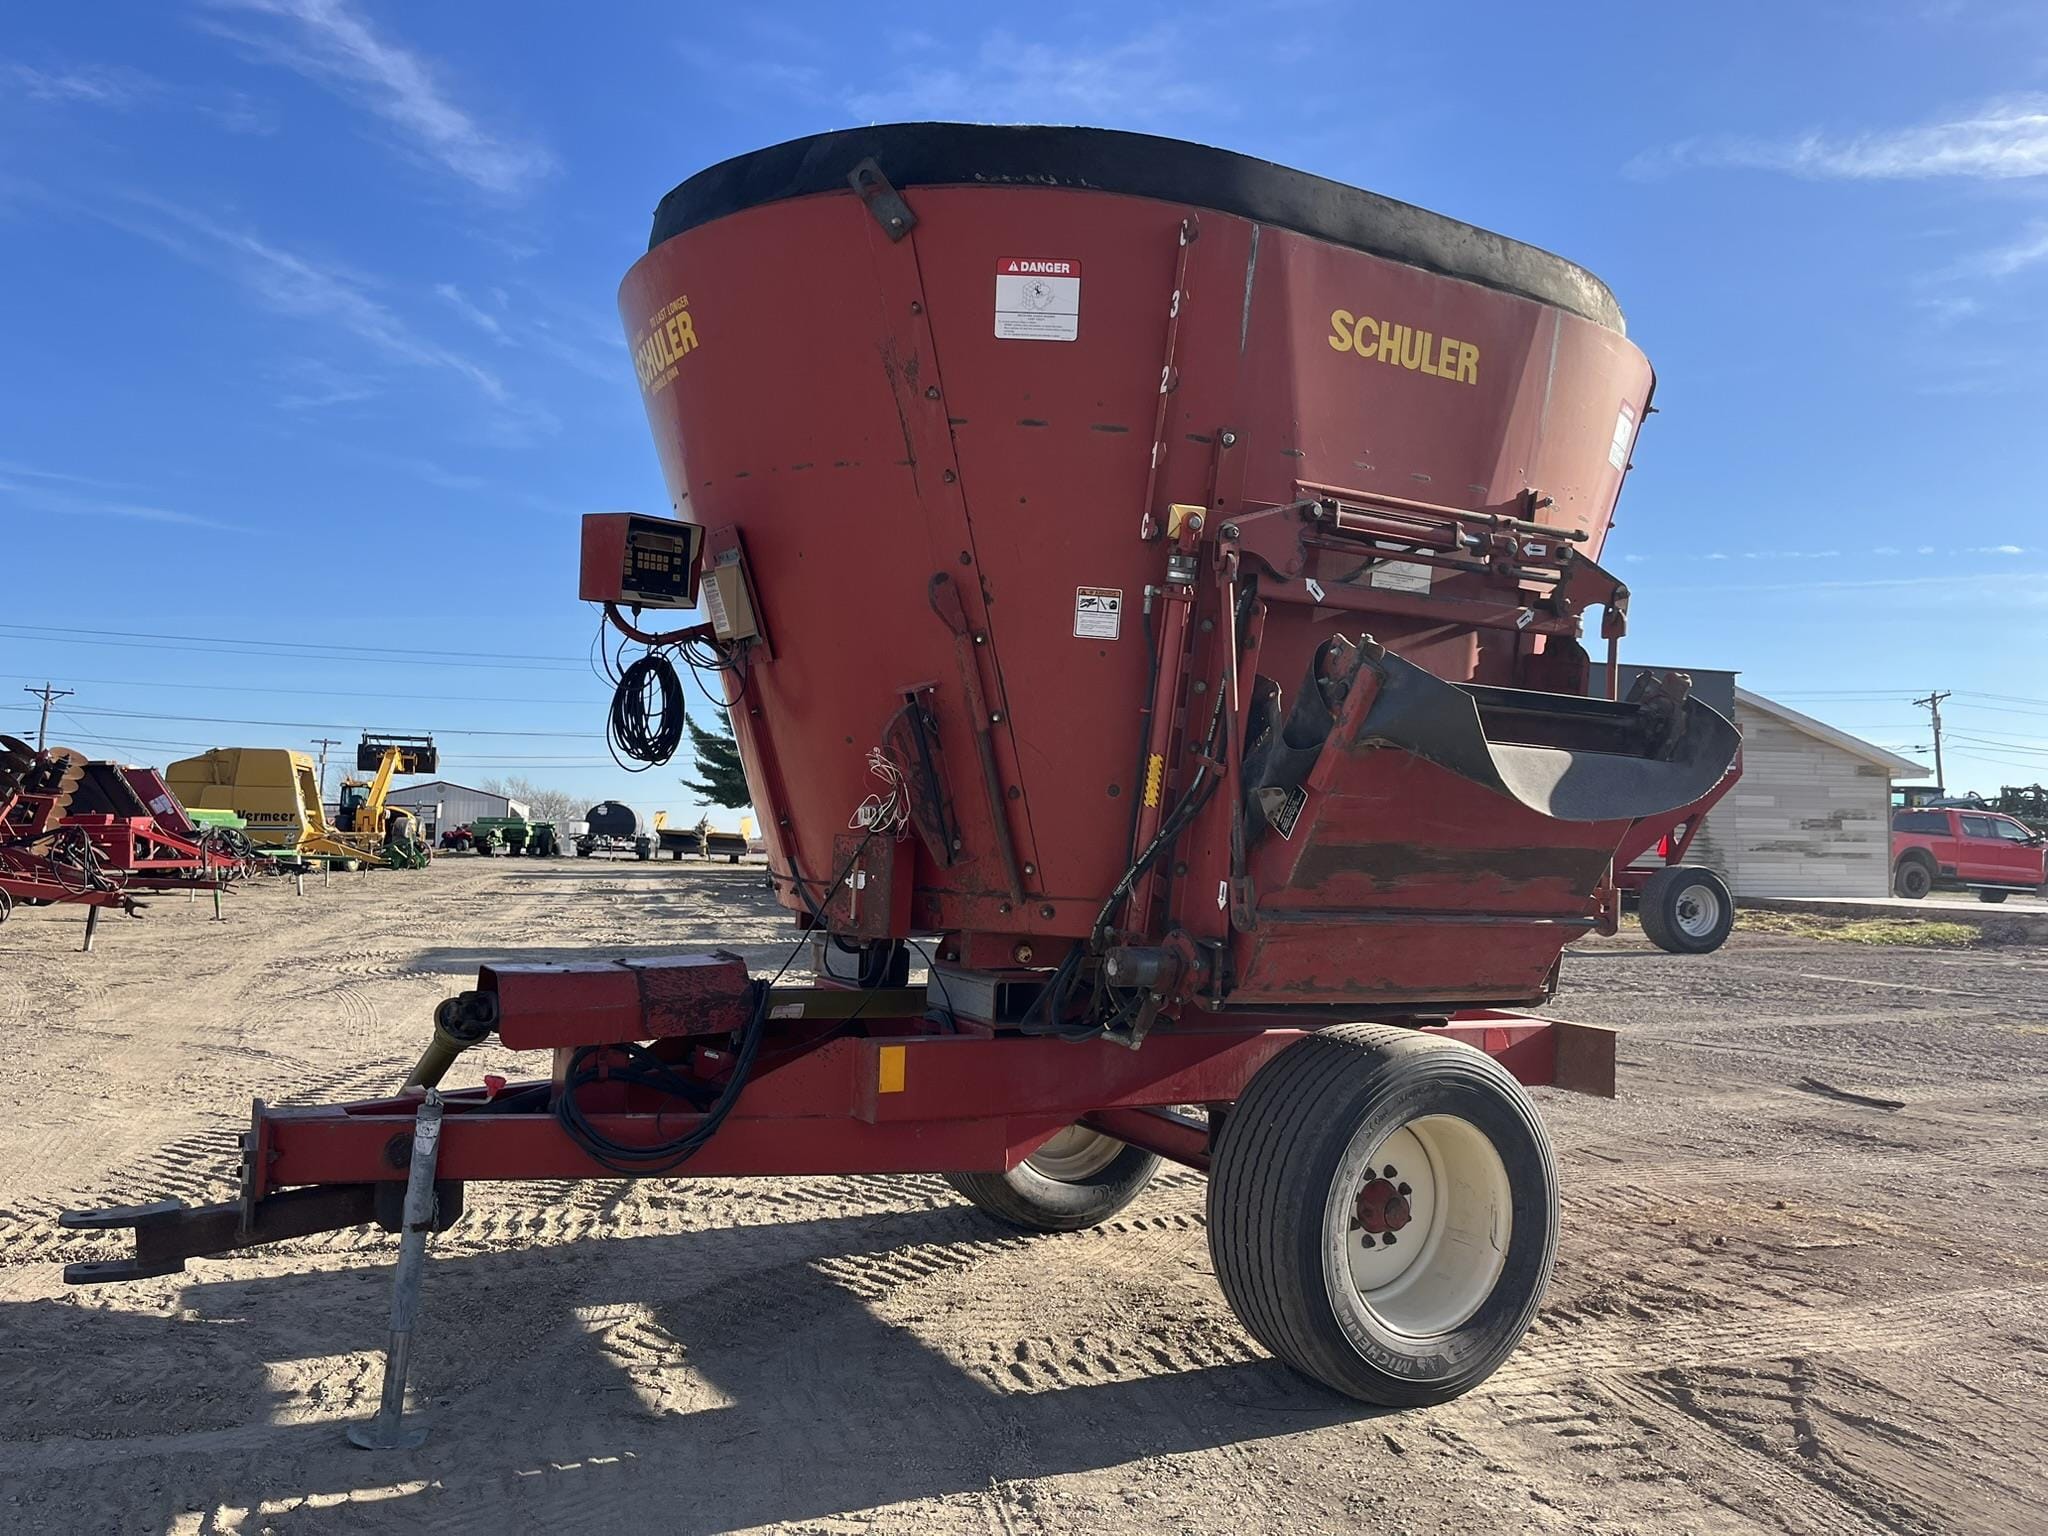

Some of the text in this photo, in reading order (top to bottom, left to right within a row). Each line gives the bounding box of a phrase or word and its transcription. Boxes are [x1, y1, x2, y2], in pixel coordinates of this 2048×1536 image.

[1020, 261, 1070, 273] DANGER
[1170, 290, 1180, 318] 3
[635, 311, 699, 393] SCHULER
[1328, 309, 1480, 385] SCHULER
[1160, 365, 1169, 393] 2
[1151, 441, 1158, 469] 1
[1141, 512, 1149, 540] C
[237, 810, 295, 822] Vermeer
[1340, 1309, 1412, 1374] MICHELIN
